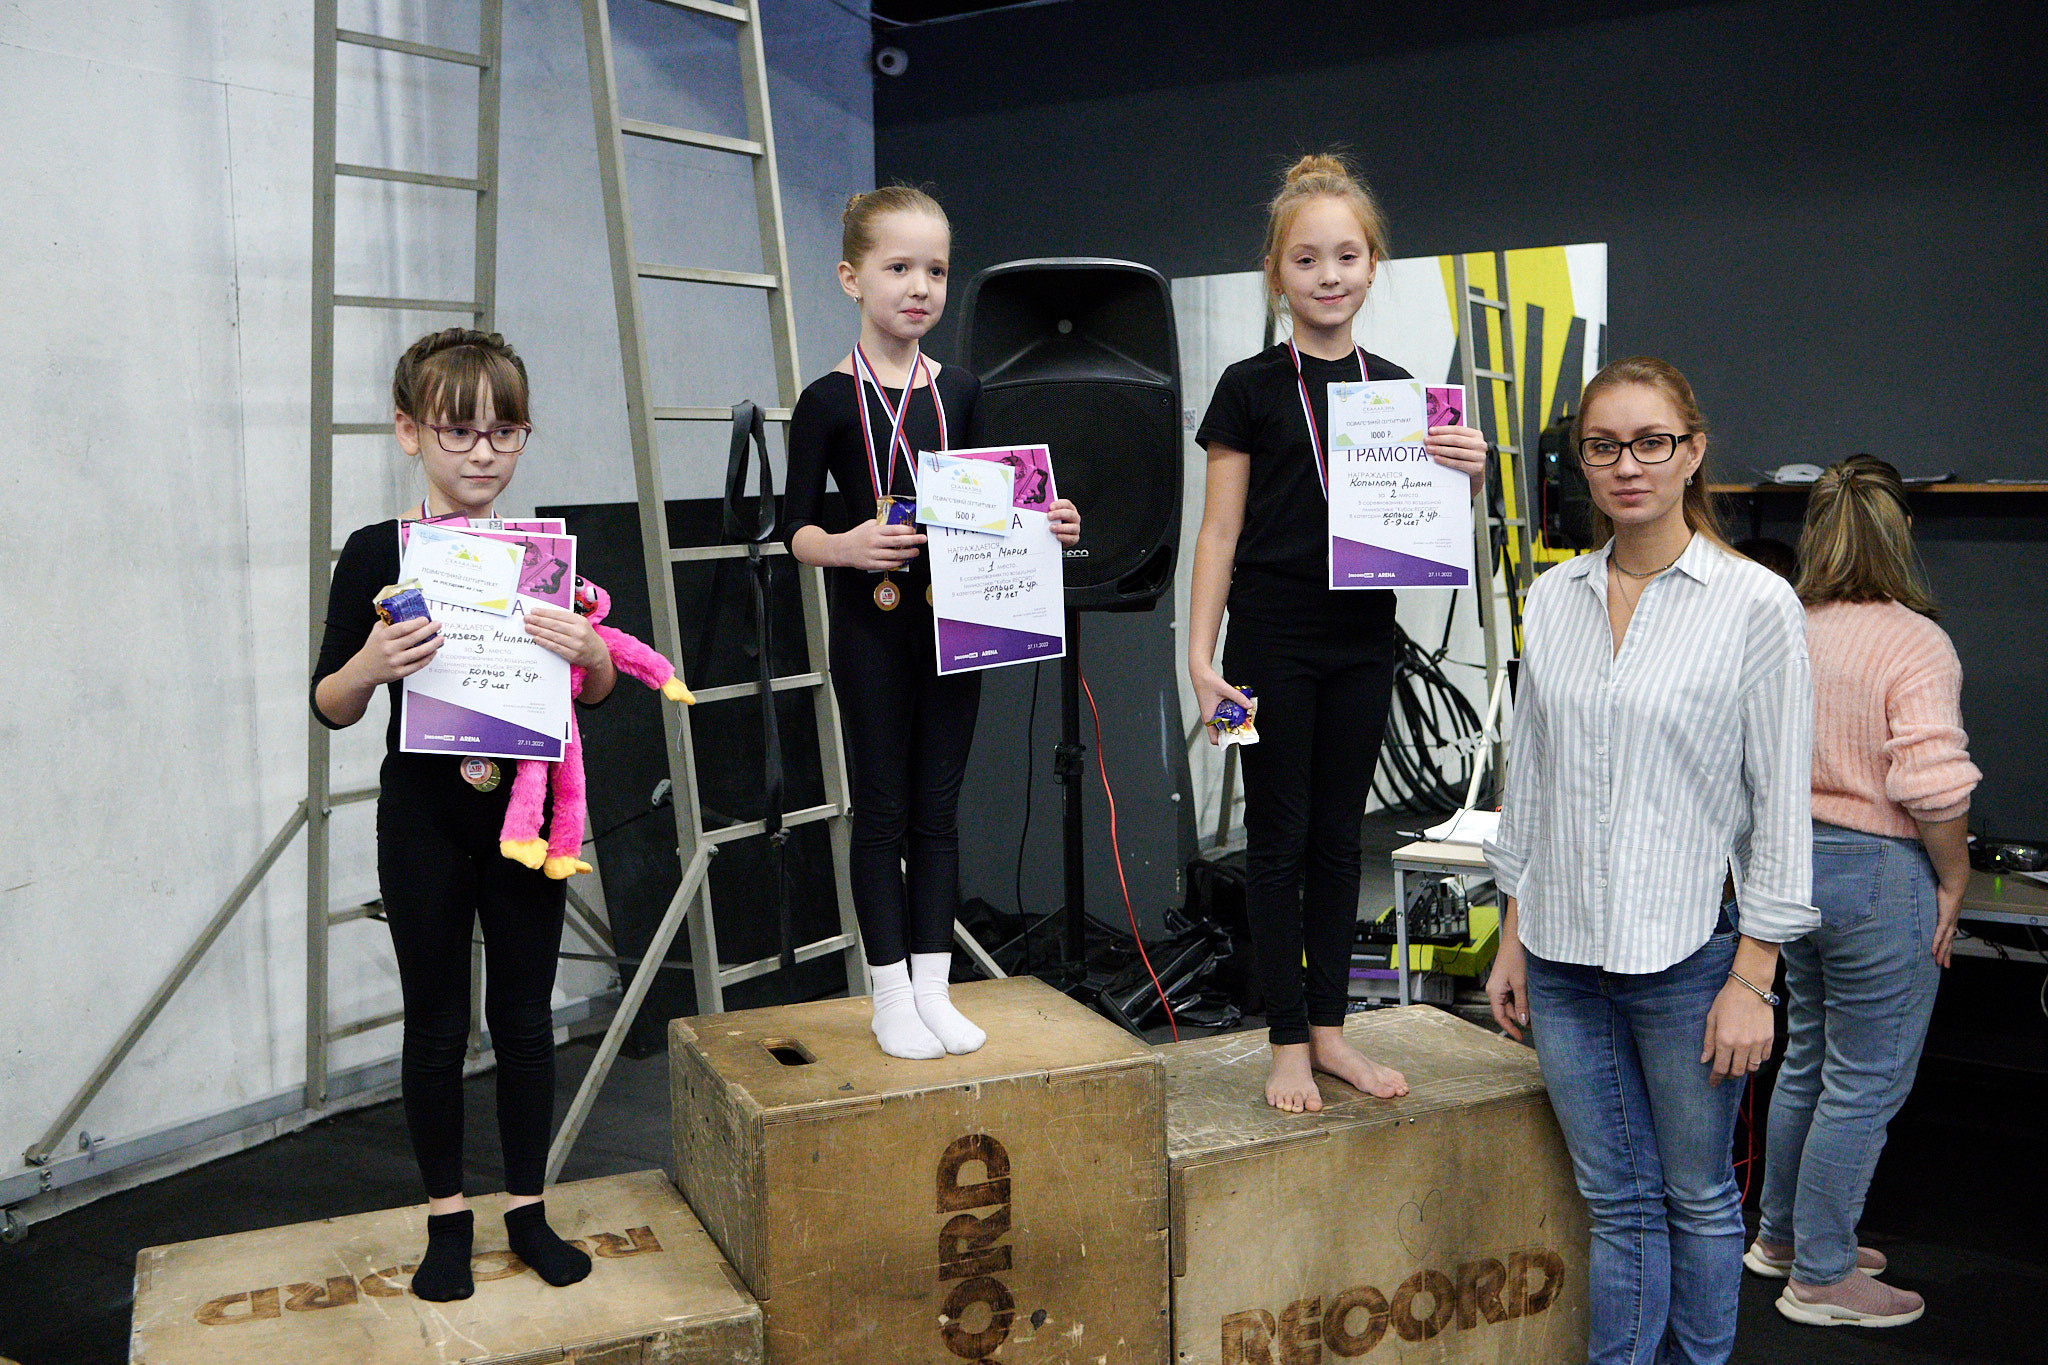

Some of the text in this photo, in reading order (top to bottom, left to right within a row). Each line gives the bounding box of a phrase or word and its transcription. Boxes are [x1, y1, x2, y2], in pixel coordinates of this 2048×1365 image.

[1371, 431, 1385, 439] 1000
[1347, 471, 1403, 479] НАГРАЖДАЕТСЯ
[1401, 477, 1432, 490] Диана
[1390, 489, 1397, 498] 2
[955, 510, 970, 520] 1500
[947, 543, 1000, 554] НАГРАЖДАЕТСЯ
[998, 547, 1028, 558] Мария
[987, 561, 994, 573] 1
[1018, 580, 1024, 588] 2
[1004, 591, 1019, 599] лет
[474, 643, 484, 654] 3
[981, 649, 998, 657] ARENA
[468, 668, 506, 677] кольцо
[523, 671, 542, 682] ур.
[517, 739, 545, 747] 27.11.2022
[936, 1134, 1015, 1365] ORD
[1221, 1250, 1566, 1365] RECORD
